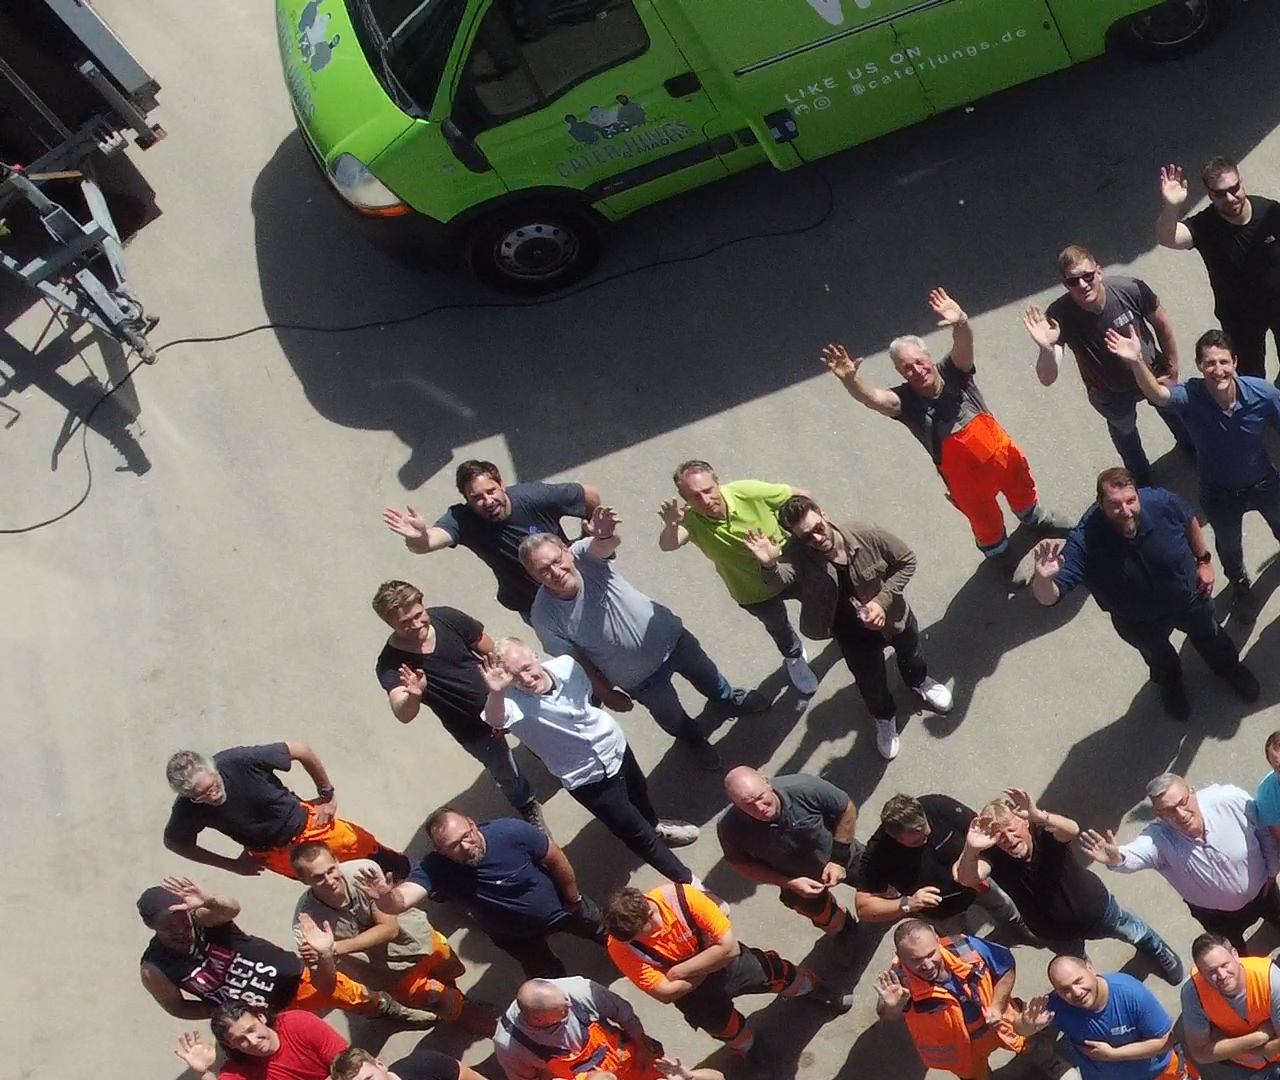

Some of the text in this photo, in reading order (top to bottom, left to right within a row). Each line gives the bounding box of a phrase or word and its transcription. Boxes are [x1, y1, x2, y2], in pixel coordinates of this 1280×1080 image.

[784, 46, 922, 104] LIKE US ON
